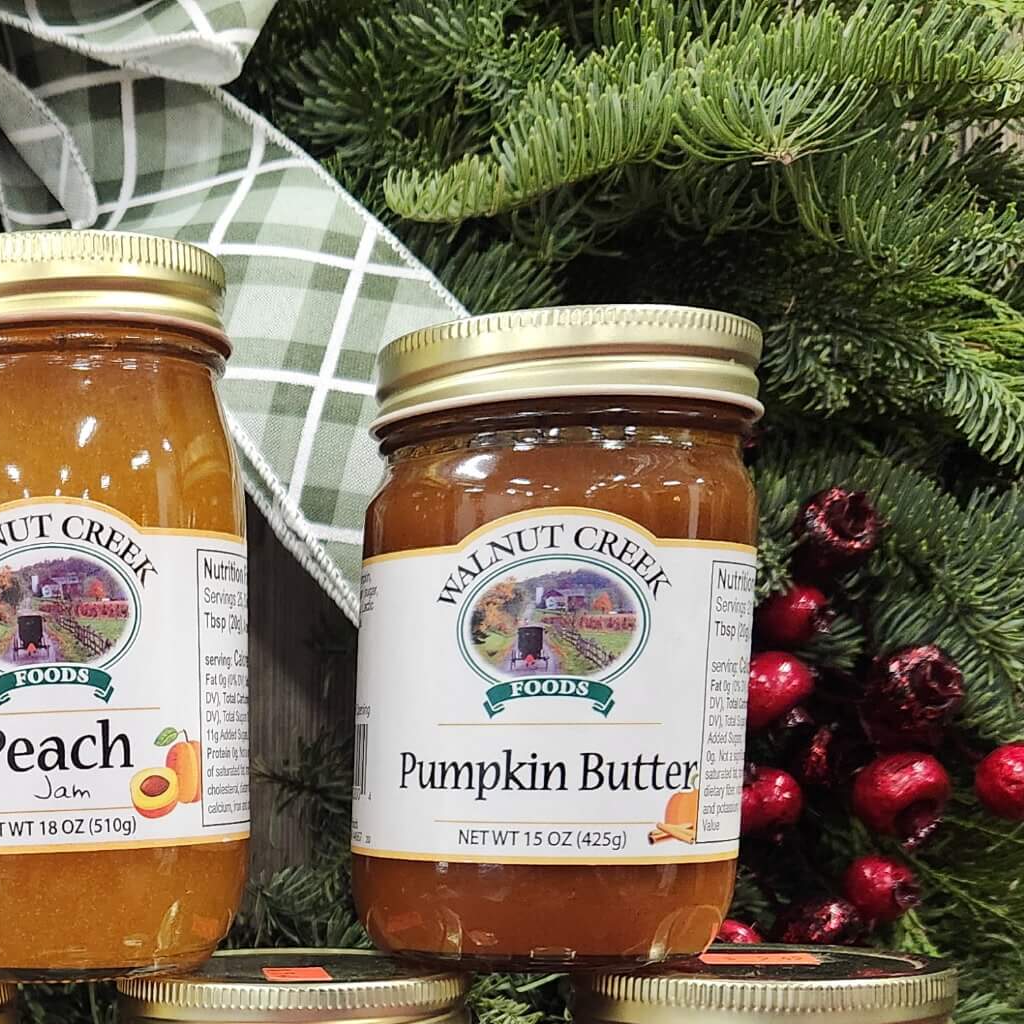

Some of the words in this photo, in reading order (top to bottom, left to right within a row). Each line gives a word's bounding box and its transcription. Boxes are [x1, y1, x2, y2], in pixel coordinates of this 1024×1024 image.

[61, 515, 159, 589] CREEK
[203, 557, 244, 586] Nutrition
[437, 523, 563, 606] WALNUT
[573, 526, 672, 602] CREEK
[204, 611, 227, 633] Tbsp
[714, 620, 736, 641] Tbsp
[15, 668, 91, 687] FOODS
[205, 673, 217, 687] Fat
[710, 678, 721, 692] Fat
[510, 681, 590, 697] FOODS
[207, 746, 231, 761] Protein
[207, 765, 215, 779] of
[399, 749, 568, 801] Pumpkin
[577, 752, 698, 792] Butter
[34, 775, 92, 800] Jam
[701, 803, 715, 816] and
[8, 821, 35, 837] WT
[39, 820, 58, 836] 18
[61, 819, 85, 834] OZ
[88, 816, 137, 836] (510g)
[702, 818, 721, 832] Value
[458, 829, 488, 846] NET
[491, 829, 518, 847] WT
[525, 830, 543, 847] 15
[547, 831, 573, 847] OZ
[576, 831, 627, 851] (425g)
